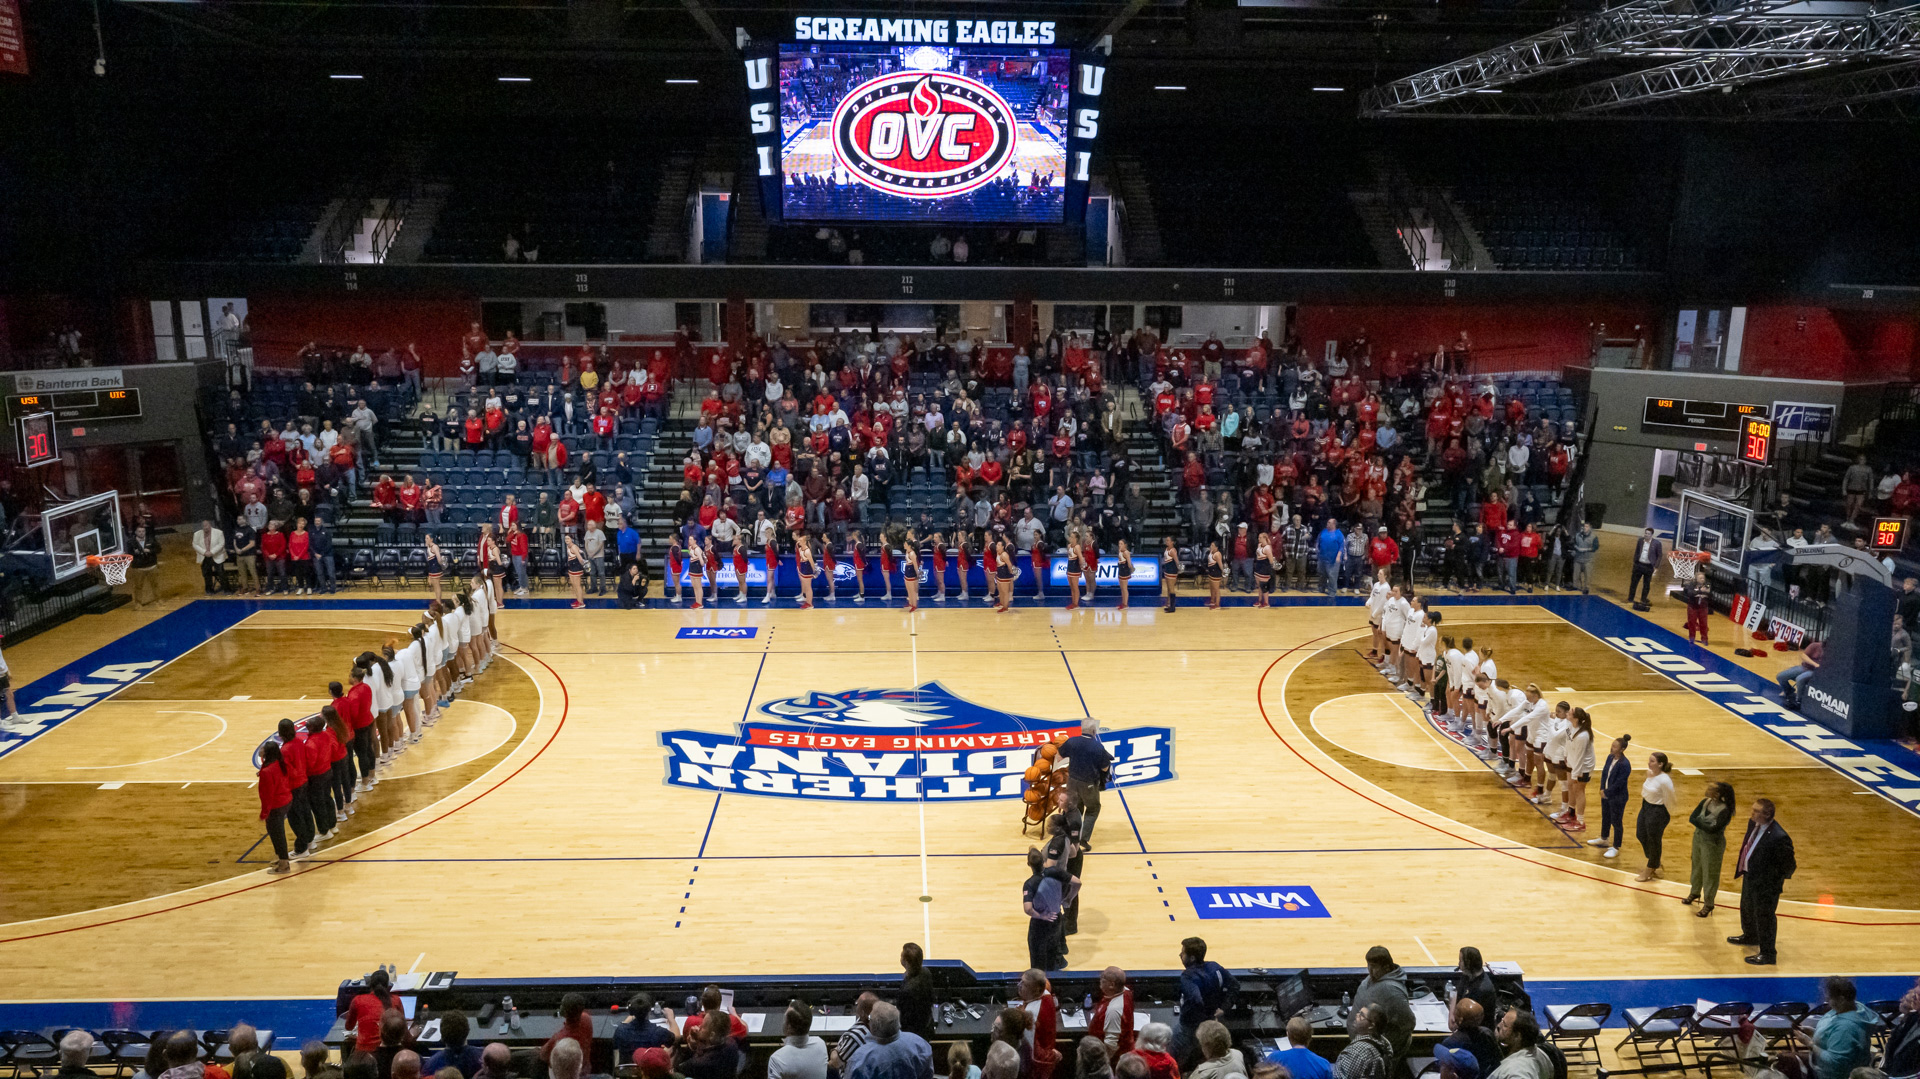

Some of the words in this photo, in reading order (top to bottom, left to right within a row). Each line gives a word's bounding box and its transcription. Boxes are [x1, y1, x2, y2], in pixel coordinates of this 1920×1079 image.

[796, 17, 949, 43] SCREAMING
[956, 20, 1056, 45] EAGLES
[851, 84, 899, 114] OHIO
[939, 84, 1005, 125] VALLEY
[744, 58, 774, 177] USI
[1077, 64, 1105, 181] USI
[869, 112, 976, 161] OVC
[858, 162, 988, 187] CONFERENCE
[575, 274, 588, 282] 213
[901, 276, 914, 284] 212
[1223, 278, 1235, 286] 211
[577, 284, 588, 292] 113
[902, 285, 914, 294] 112
[1223, 288, 1234, 296] 111
[36, 379, 88, 390] Banterra
[91, 376, 121, 387] Bank
[20, 396, 39, 405] USI
[109, 390, 126, 399] UIC
[1658, 399, 1673, 408] USI
[1738, 405, 1754, 414] UIC
[1748, 421, 1770, 438] 10:00
[28, 433, 48, 459] 30
[1747, 435, 1766, 461] 30
[1878, 522, 1900, 532] 10:00
[1877, 533, 1895, 545] 30
[1747, 603, 1762, 630] BLUE
[685, 628, 748, 637] WNIT
[1768, 619, 1804, 645] EAGLES
[1807, 685, 1850, 715] ROMAIN
[1604, 636, 1920, 810] SOUTHE
[768, 733, 876, 748] EAGLES
[893, 731, 1068, 749] SCREAMING
[1208, 892, 1312, 910] WNIT
